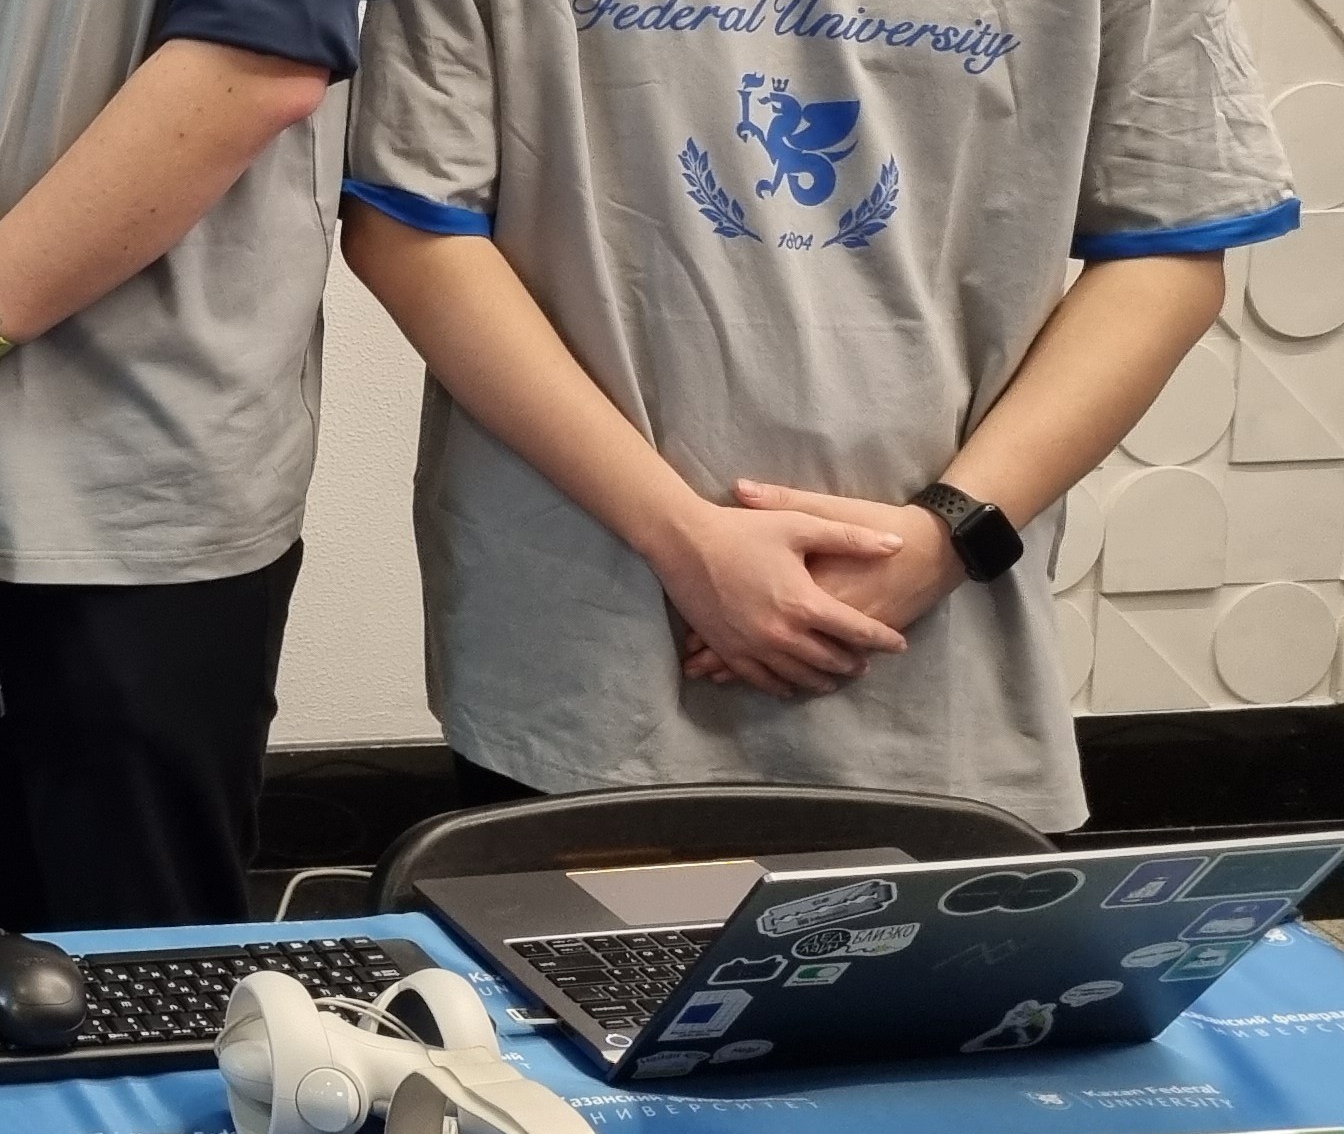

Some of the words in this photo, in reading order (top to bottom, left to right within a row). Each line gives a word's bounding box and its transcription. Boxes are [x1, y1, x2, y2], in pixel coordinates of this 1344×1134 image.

[777, 231, 813, 251] 1804
[852, 924, 916, 944] БЛИЗКО
[1145, 1082, 1221, 1096] Federal
[589, 1099, 821, 1126] НИВЕРСИТЕТ
[1097, 1097, 1235, 1110] UNIVERSITY
